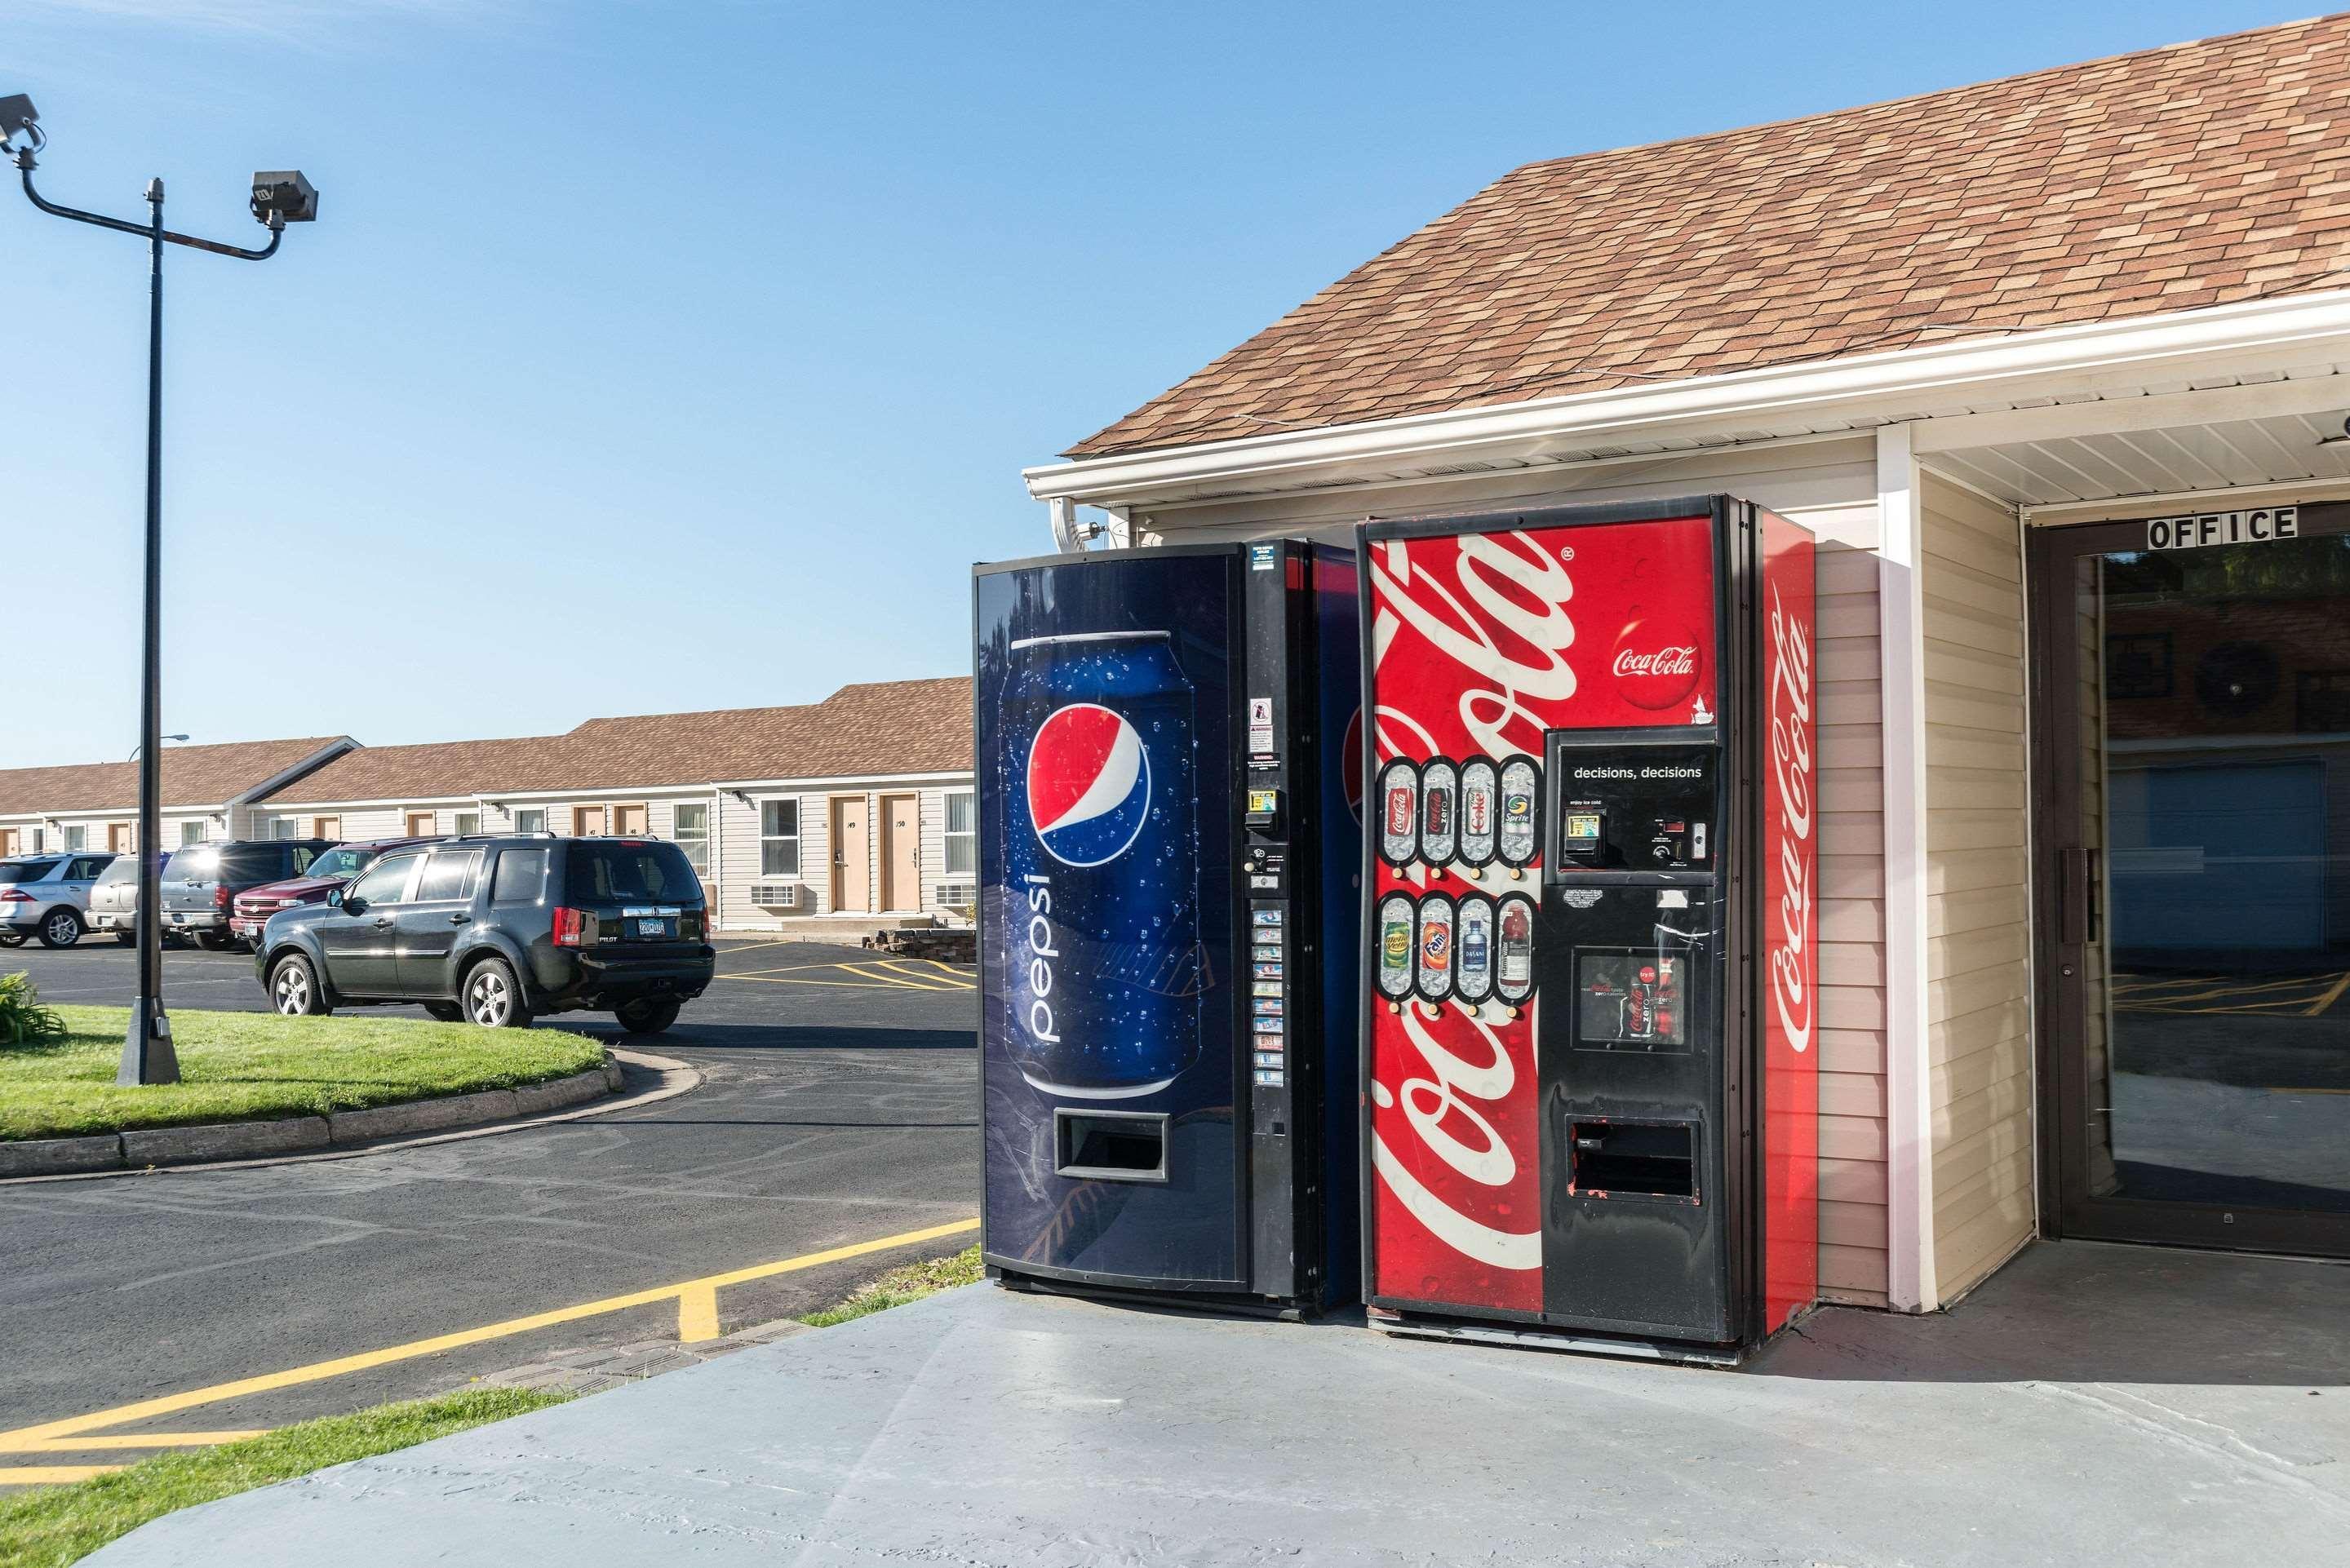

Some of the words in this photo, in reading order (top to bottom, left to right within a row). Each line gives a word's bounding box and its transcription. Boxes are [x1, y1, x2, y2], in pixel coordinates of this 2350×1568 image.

[2149, 508, 2295, 548] OFFICE
[1612, 645, 1697, 677] Coca-Cola
[1574, 767, 1637, 780] decisions,
[1641, 767, 1701, 778] decisions
[1471, 793, 1484, 830] Coke
[1505, 813, 1529, 824] Sprite
[1770, 578, 1811, 1054] Coca-Cola
[1024, 875, 1060, 1043] pepsi
